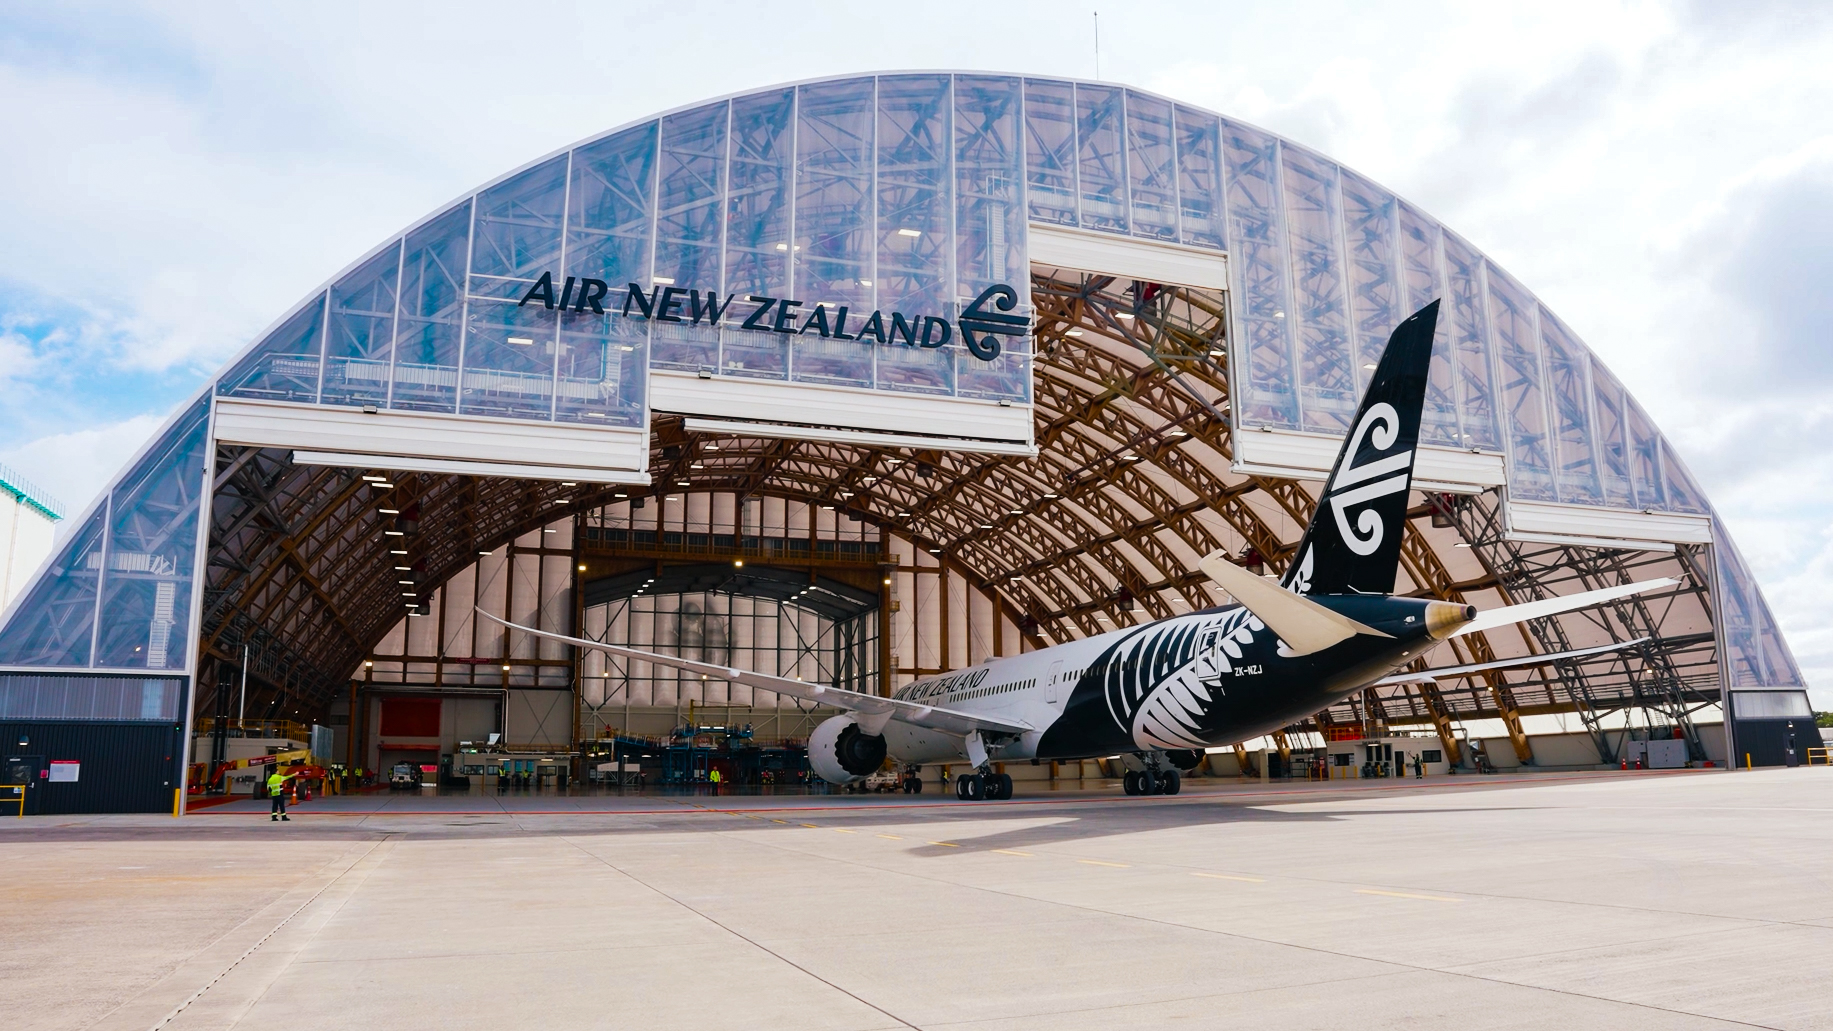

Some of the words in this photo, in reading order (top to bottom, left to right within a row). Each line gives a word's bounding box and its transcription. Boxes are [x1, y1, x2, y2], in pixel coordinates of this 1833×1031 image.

[518, 271, 608, 314] AIR
[623, 283, 735, 325] NEW
[741, 295, 951, 348] ZEALAND
[905, 680, 937, 701] NEW
[929, 668, 990, 697] ZEALAND
[1234, 664, 1262, 677] ZK-NZJ
